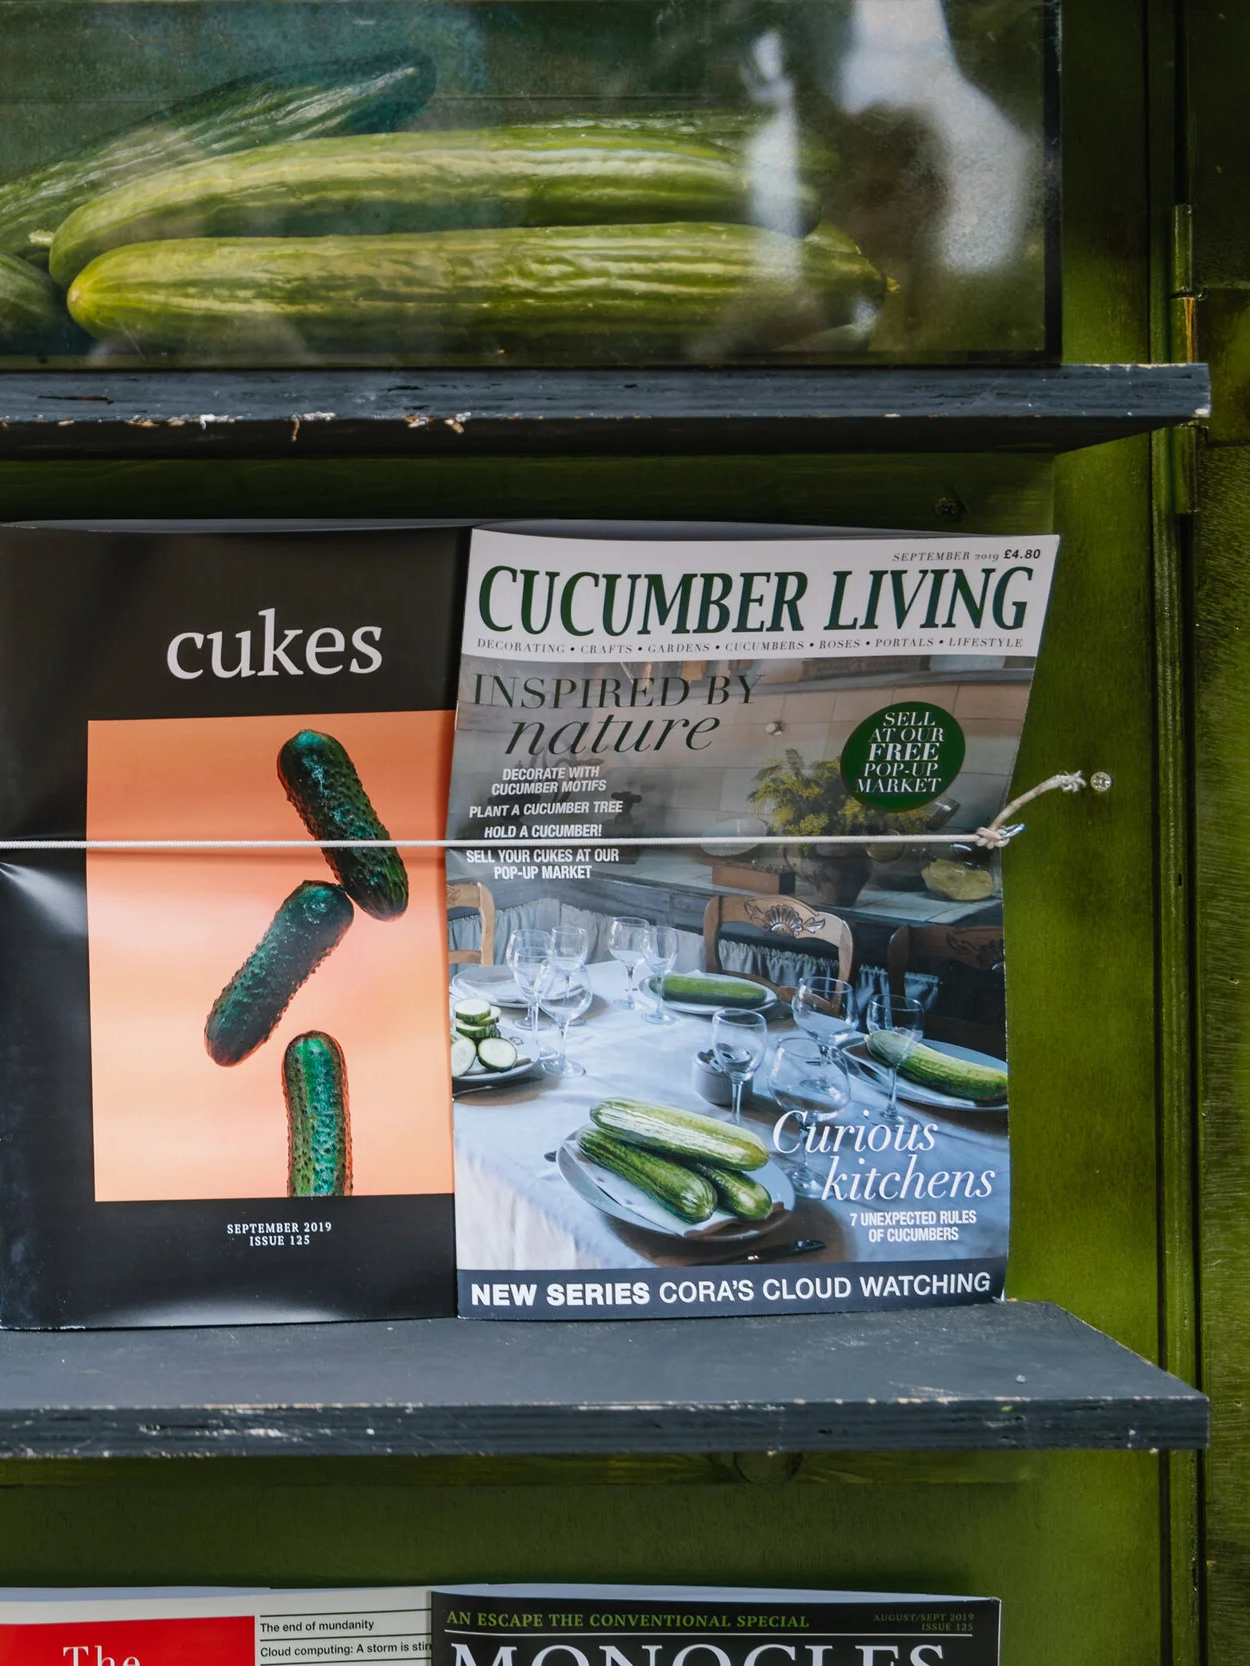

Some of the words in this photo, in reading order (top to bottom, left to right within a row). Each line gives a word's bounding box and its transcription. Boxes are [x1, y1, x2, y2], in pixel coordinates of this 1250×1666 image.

[892, 551, 970, 562] SEPTEMBER
[974, 553, 999, 563] 2019
[1004, 549, 1041, 559] £4.80
[478, 565, 809, 636] CUCUMBER
[823, 566, 1034, 631] LIVING
[166, 607, 383, 680] cukes
[477, 638, 565, 654] DECORATING
[580, 645, 632, 654] CRAFTS
[648, 643, 710, 653] GARDENS
[725, 640, 804, 651] CUCUMBERS
[819, 639, 861, 649] ROSES
[875, 638, 934, 648] PORTALS
[949, 637, 1023, 648] LIFESTYLE
[473, 673, 690, 708] INSPIRED
[702, 674, 765, 705] BY
[883, 711, 936, 726] SELL
[505, 714, 720, 755] nature
[868, 728, 896, 742] AT
[900, 727, 944, 742] OUR
[866, 743, 940, 761] FREE
[503, 767, 566, 780] DECORATE
[569, 766, 600, 778] WITH
[864, 762, 938, 777] POP-UP
[492, 782, 558, 795] CUCUMBER
[561, 780, 606, 792] MOTIFS
[855, 778, 942, 793] MARKET
[470, 805, 509, 818] PLANT
[511, 804, 520, 815] A
[524, 802, 589, 814] CUCUMBER
[593, 801, 623, 813] TREE
[484, 826, 516, 838] HOLD
[520, 826, 528, 837] A
[532, 824, 602, 837] CUCUMBER!
[466, 850, 495, 863] SELL
[498, 850, 530, 863] YOUR
[533, 850, 573, 862] CUKES
[576, 849, 591, 862] AT
[594, 849, 619, 861] OUR
[494, 867, 538, 879] POP-UP
[542, 865, 592, 879] MARKET
[773, 1110, 938, 1154] Curious
[821, 1155, 995, 1201] kitchens
[850, 1213, 858, 1226] 7
[861, 1211, 936, 1226] UNEXPECTED
[940, 1210, 977, 1224] RULES
[227, 1223, 299, 1234] SEPTEMBER
[303, 1222, 332, 1232] 2019
[869, 1229, 885, 1243] OF
[887, 1227, 959, 1242] CUCUMBERS
[250, 1235, 284, 1246] ISSUE
[290, 1235, 310, 1245] 125
[471, 1283, 537, 1306] NEW
[547, 1282, 649, 1306] SERIES
[658, 1279, 754, 1304] CORA'S
[762, 1277, 851, 1302] CLOUD
[860, 1272, 991, 1297] WATCHING
[446, 1611, 471, 1625] AN
[477, 1613, 543, 1627] ESCAPE
[548, 1614, 584, 1626] THE
[589, 1614, 731, 1627] CONVENTIONAL
[737, 1614, 810, 1628] SPECIAL
[873, 1614, 947, 1622] AUGUST/SEPT
[950, 1613, 974, 1621] 2019
[260, 1623, 280, 1633] The
[283, 1622, 302, 1632] end
[305, 1621, 316, 1631] of
[319, 1619, 375, 1631] mundanity
[921, 1623, 952, 1631] ISSUE
[260, 1646, 291, 1657] Cloud
[294, 1643, 354, 1658] computing:
[356, 1644, 365, 1653] A
[367, 1643, 397, 1653] storm
[400, 1642, 409, 1652] is
